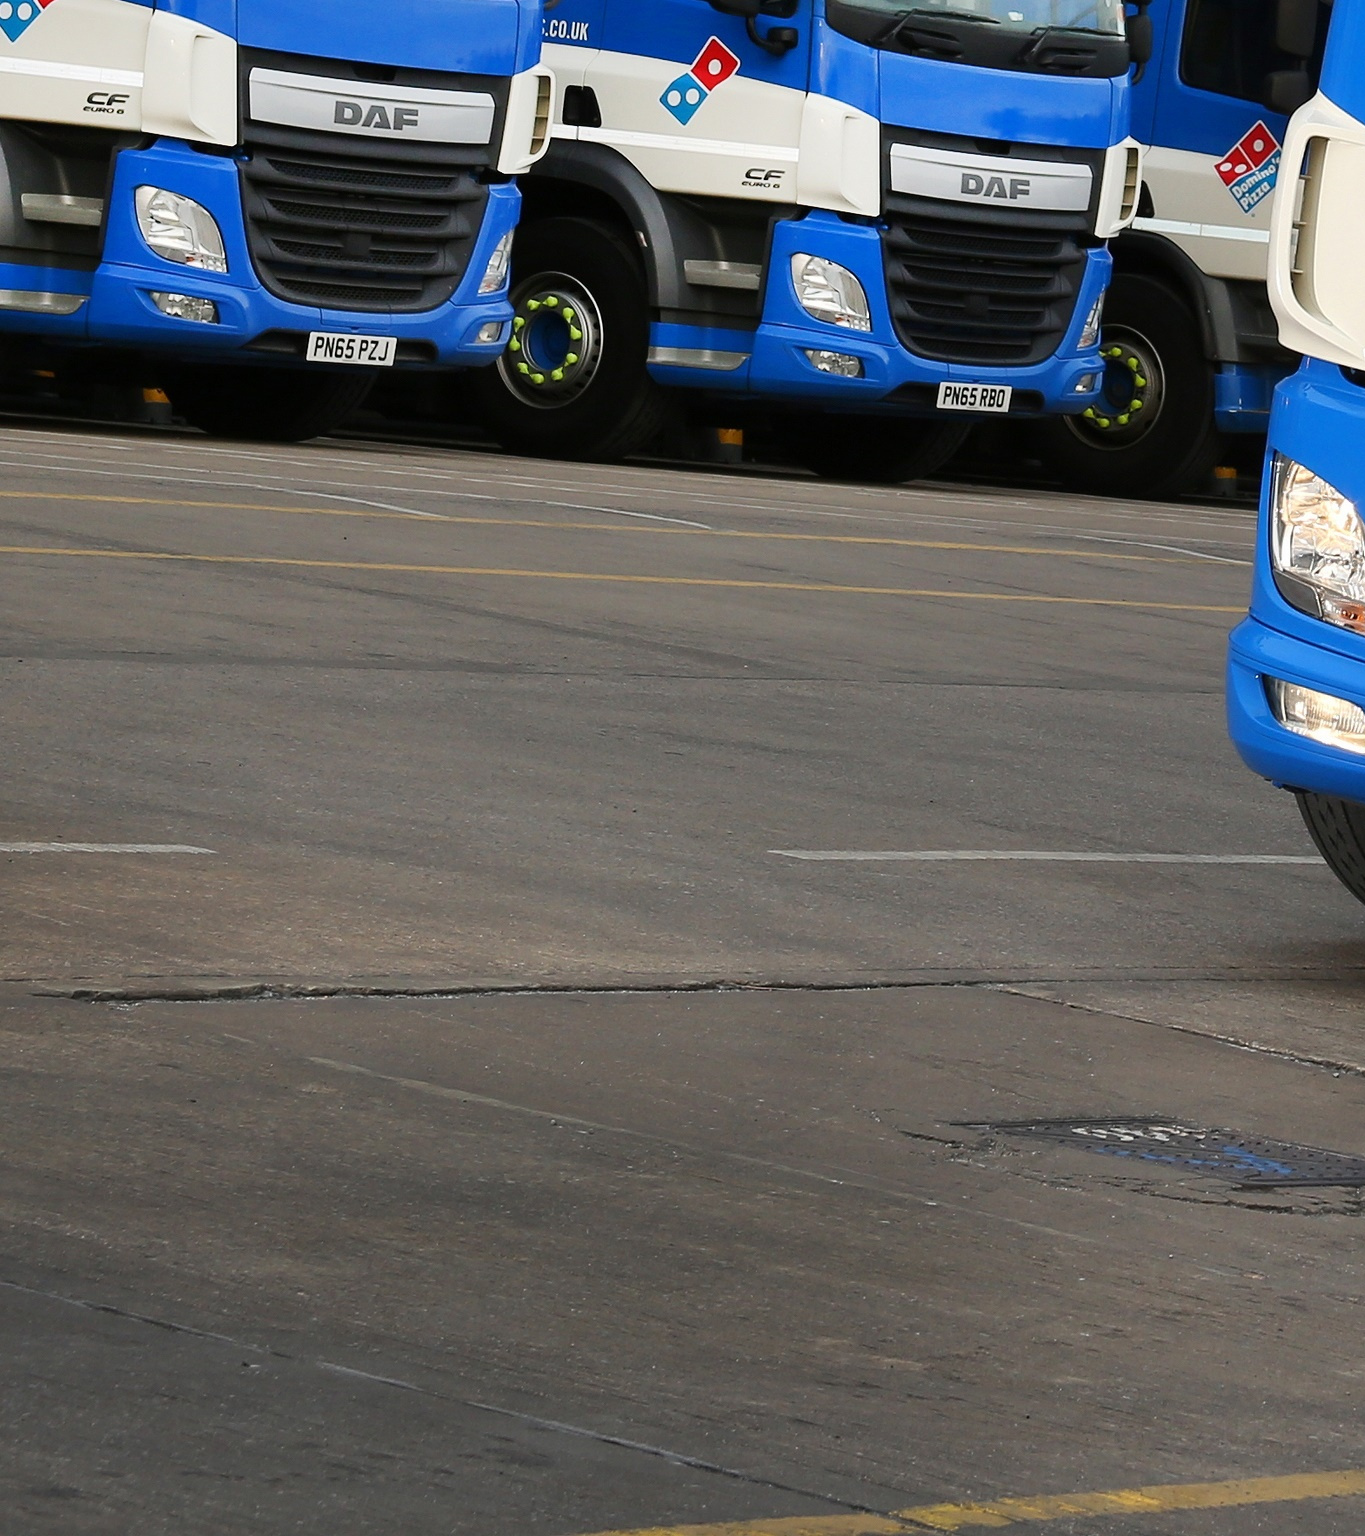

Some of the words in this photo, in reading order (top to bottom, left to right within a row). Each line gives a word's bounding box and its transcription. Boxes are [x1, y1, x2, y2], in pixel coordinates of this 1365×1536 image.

[83, 105, 114, 114] EURO
[86, 91, 130, 106] CF
[334, 100, 418, 131] DAF
[745, 167, 785, 181] CF
[960, 172, 1030, 200] DAF
[1239, 181, 1271, 211] Pizza
[313, 336, 356, 359] PN65
[357, 339, 389, 362] PZJ
[943, 385, 978, 407] PN65
[979, 388, 1006, 408] RBO
